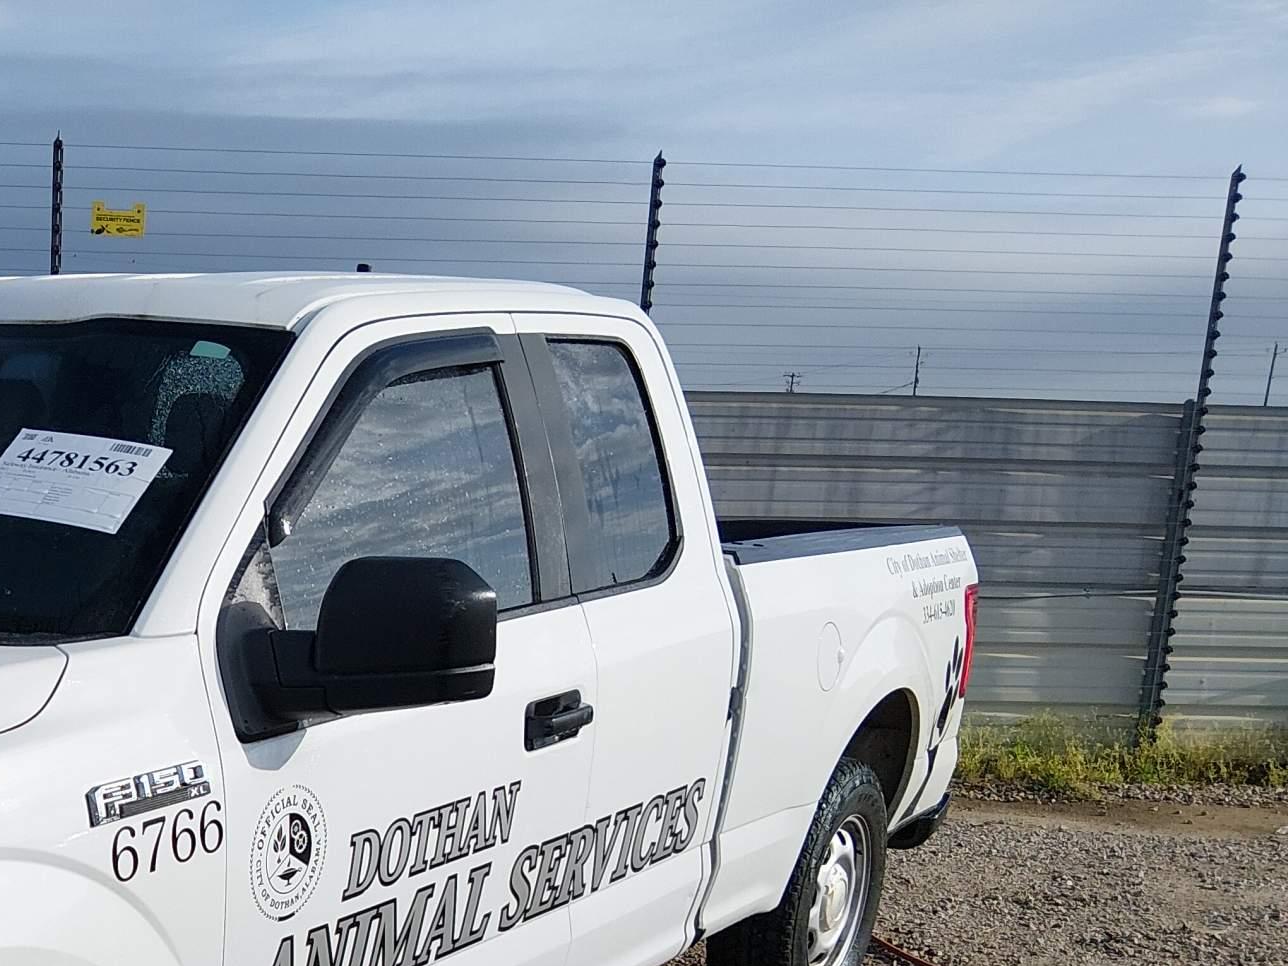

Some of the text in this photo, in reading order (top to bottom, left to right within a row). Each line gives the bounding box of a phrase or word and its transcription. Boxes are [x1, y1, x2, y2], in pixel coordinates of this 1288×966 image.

[16, 448, 138, 477] 44781563
[886, 557, 903, 578] City
[908, 553, 932, 571] Dothan
[930, 550, 949, 566] Animal
[912, 574, 961, 599] & Adoption Center
[190, 784, 208, 797] XL
[112, 800, 224, 882] 6766
[256, 794, 321, 851] OFFICIAL SEAL
[342, 780, 521, 902] DOTHAN
[255, 859, 263, 887] CITY
[261, 888, 270, 901] OF
[301, 839, 321, 896] ALABAMA
[497, 778, 707, 932] SERVICES
